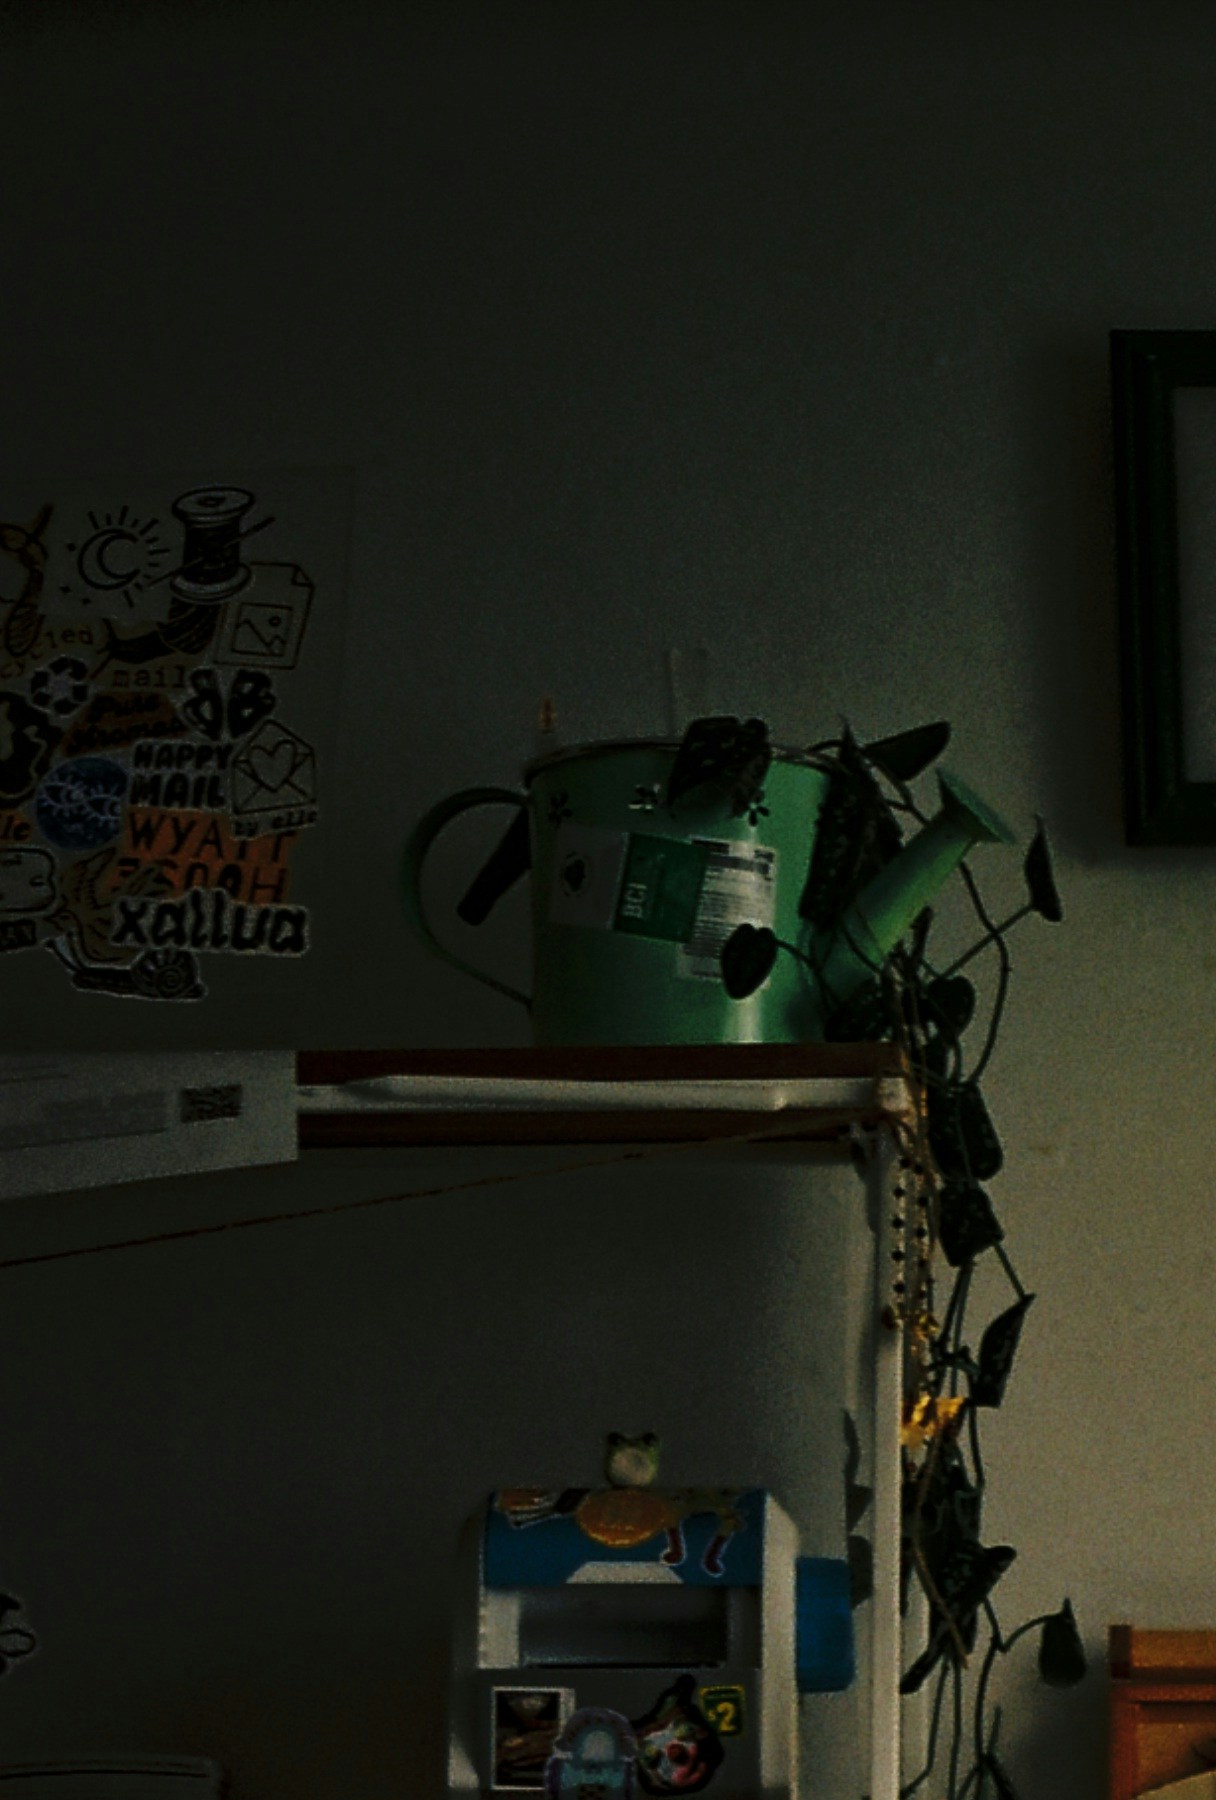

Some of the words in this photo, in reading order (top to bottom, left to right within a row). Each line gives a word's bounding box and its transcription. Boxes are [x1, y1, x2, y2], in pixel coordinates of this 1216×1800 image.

[112, 664, 187, 689] mail
[133, 744, 233, 769] HAPPY
[129, 772, 226, 807] MAIL
[621, 881, 648, 919] BCI
[110, 889, 307, 952] xallua
